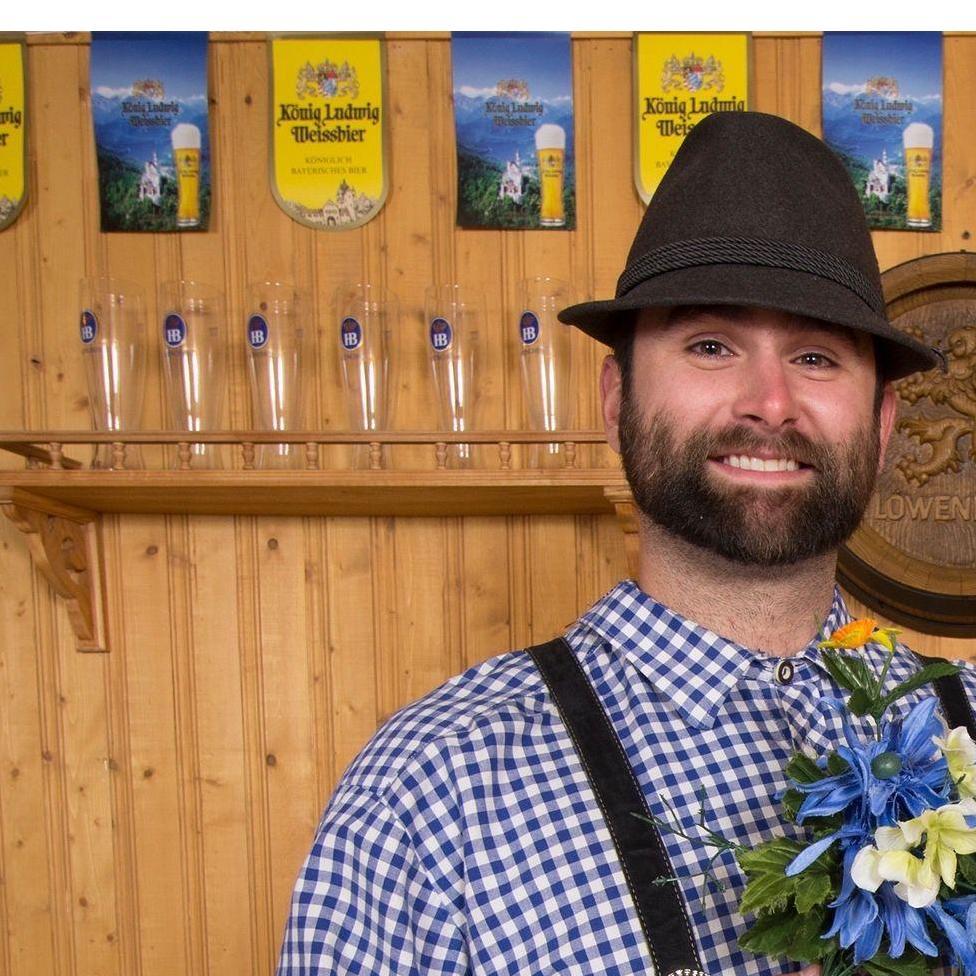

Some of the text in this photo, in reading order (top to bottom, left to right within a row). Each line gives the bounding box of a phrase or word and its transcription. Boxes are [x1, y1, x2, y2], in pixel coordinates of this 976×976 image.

[277, 102, 380, 127] König Ludwig
[642, 96, 745, 120] König Ludwig
[291, 125, 366, 143] Weissbier
[81, 326, 93, 340] HB
[167, 329, 182, 343] HB
[250, 330, 264, 344] HB
[344, 332, 358, 346] HB
[433, 333, 448, 347] HB
[522, 327, 536, 341] HB
